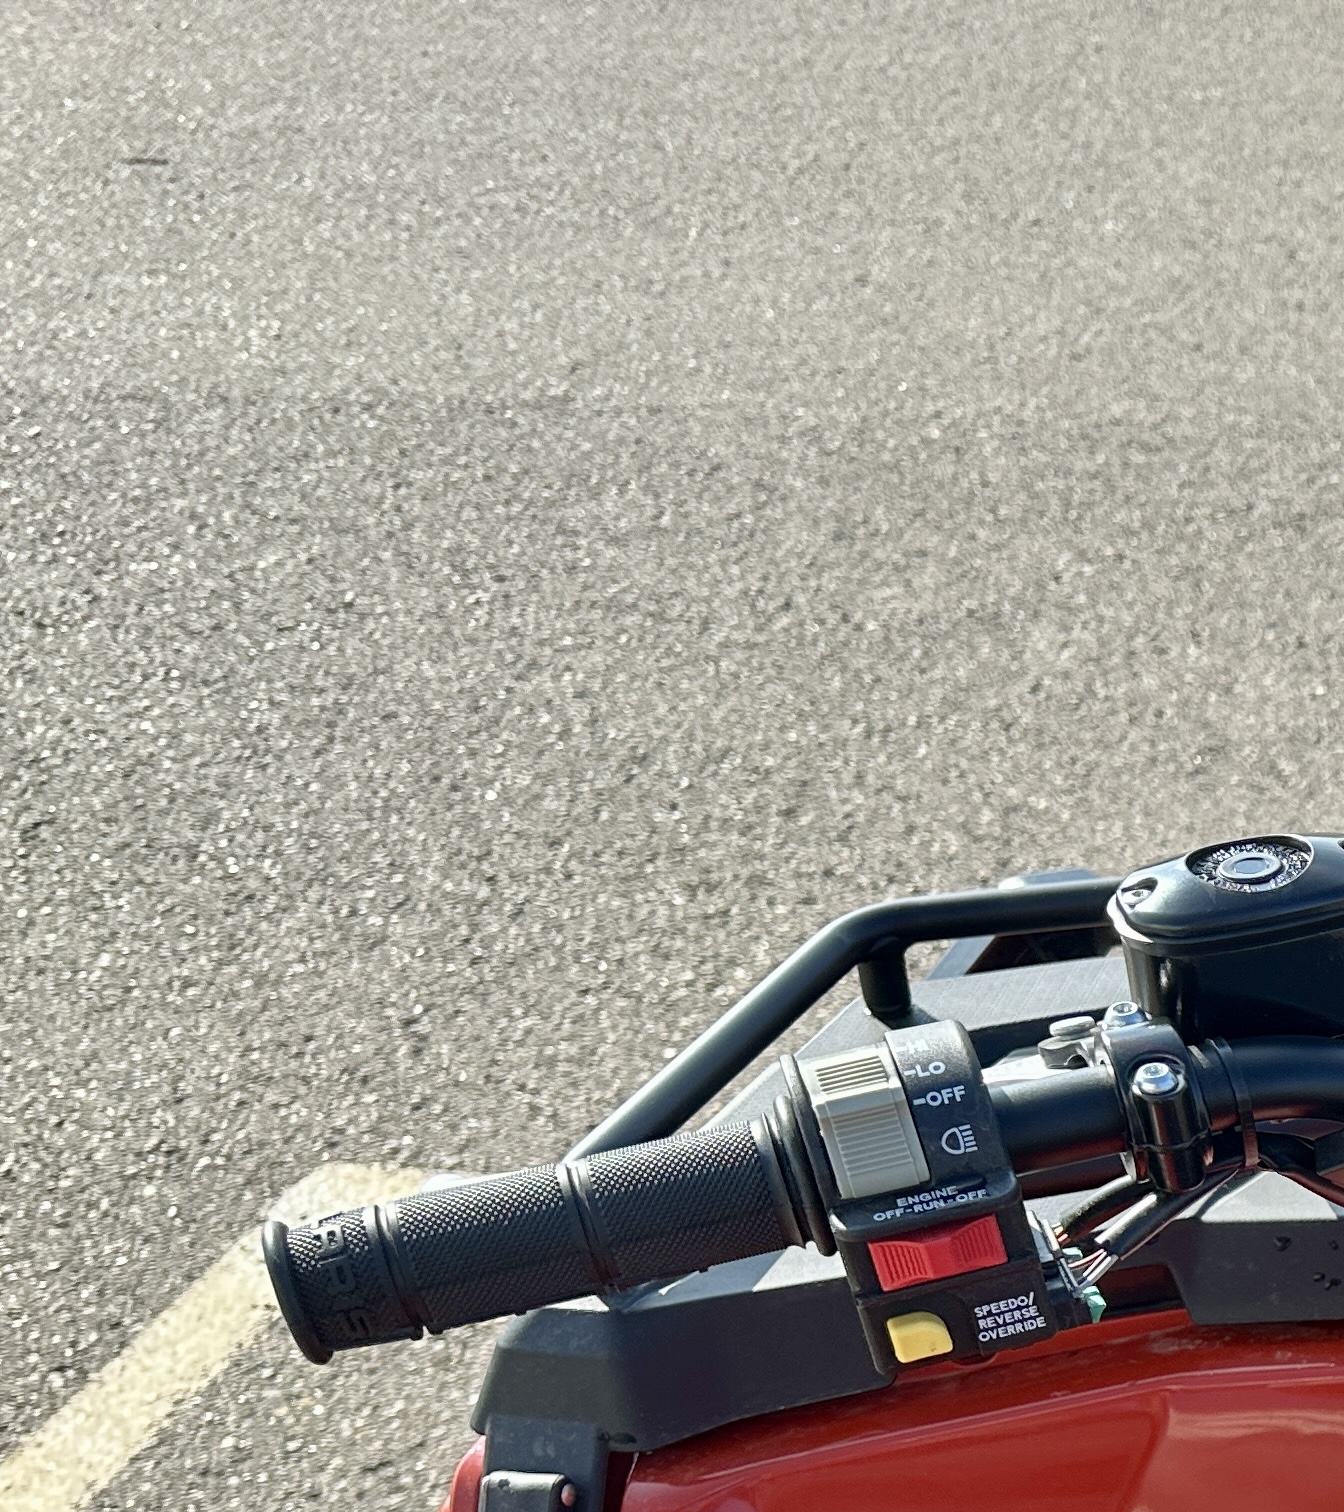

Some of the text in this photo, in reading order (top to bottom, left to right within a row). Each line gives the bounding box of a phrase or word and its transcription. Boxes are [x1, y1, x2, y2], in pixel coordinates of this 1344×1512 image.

[896, 1185, 958, 1208] ENGINE
[974, 1292, 1035, 1318] SPEEDO/
[978, 1304, 1040, 1330] REVERSE
[978, 1316, 1047, 1343] OVERRIDE
